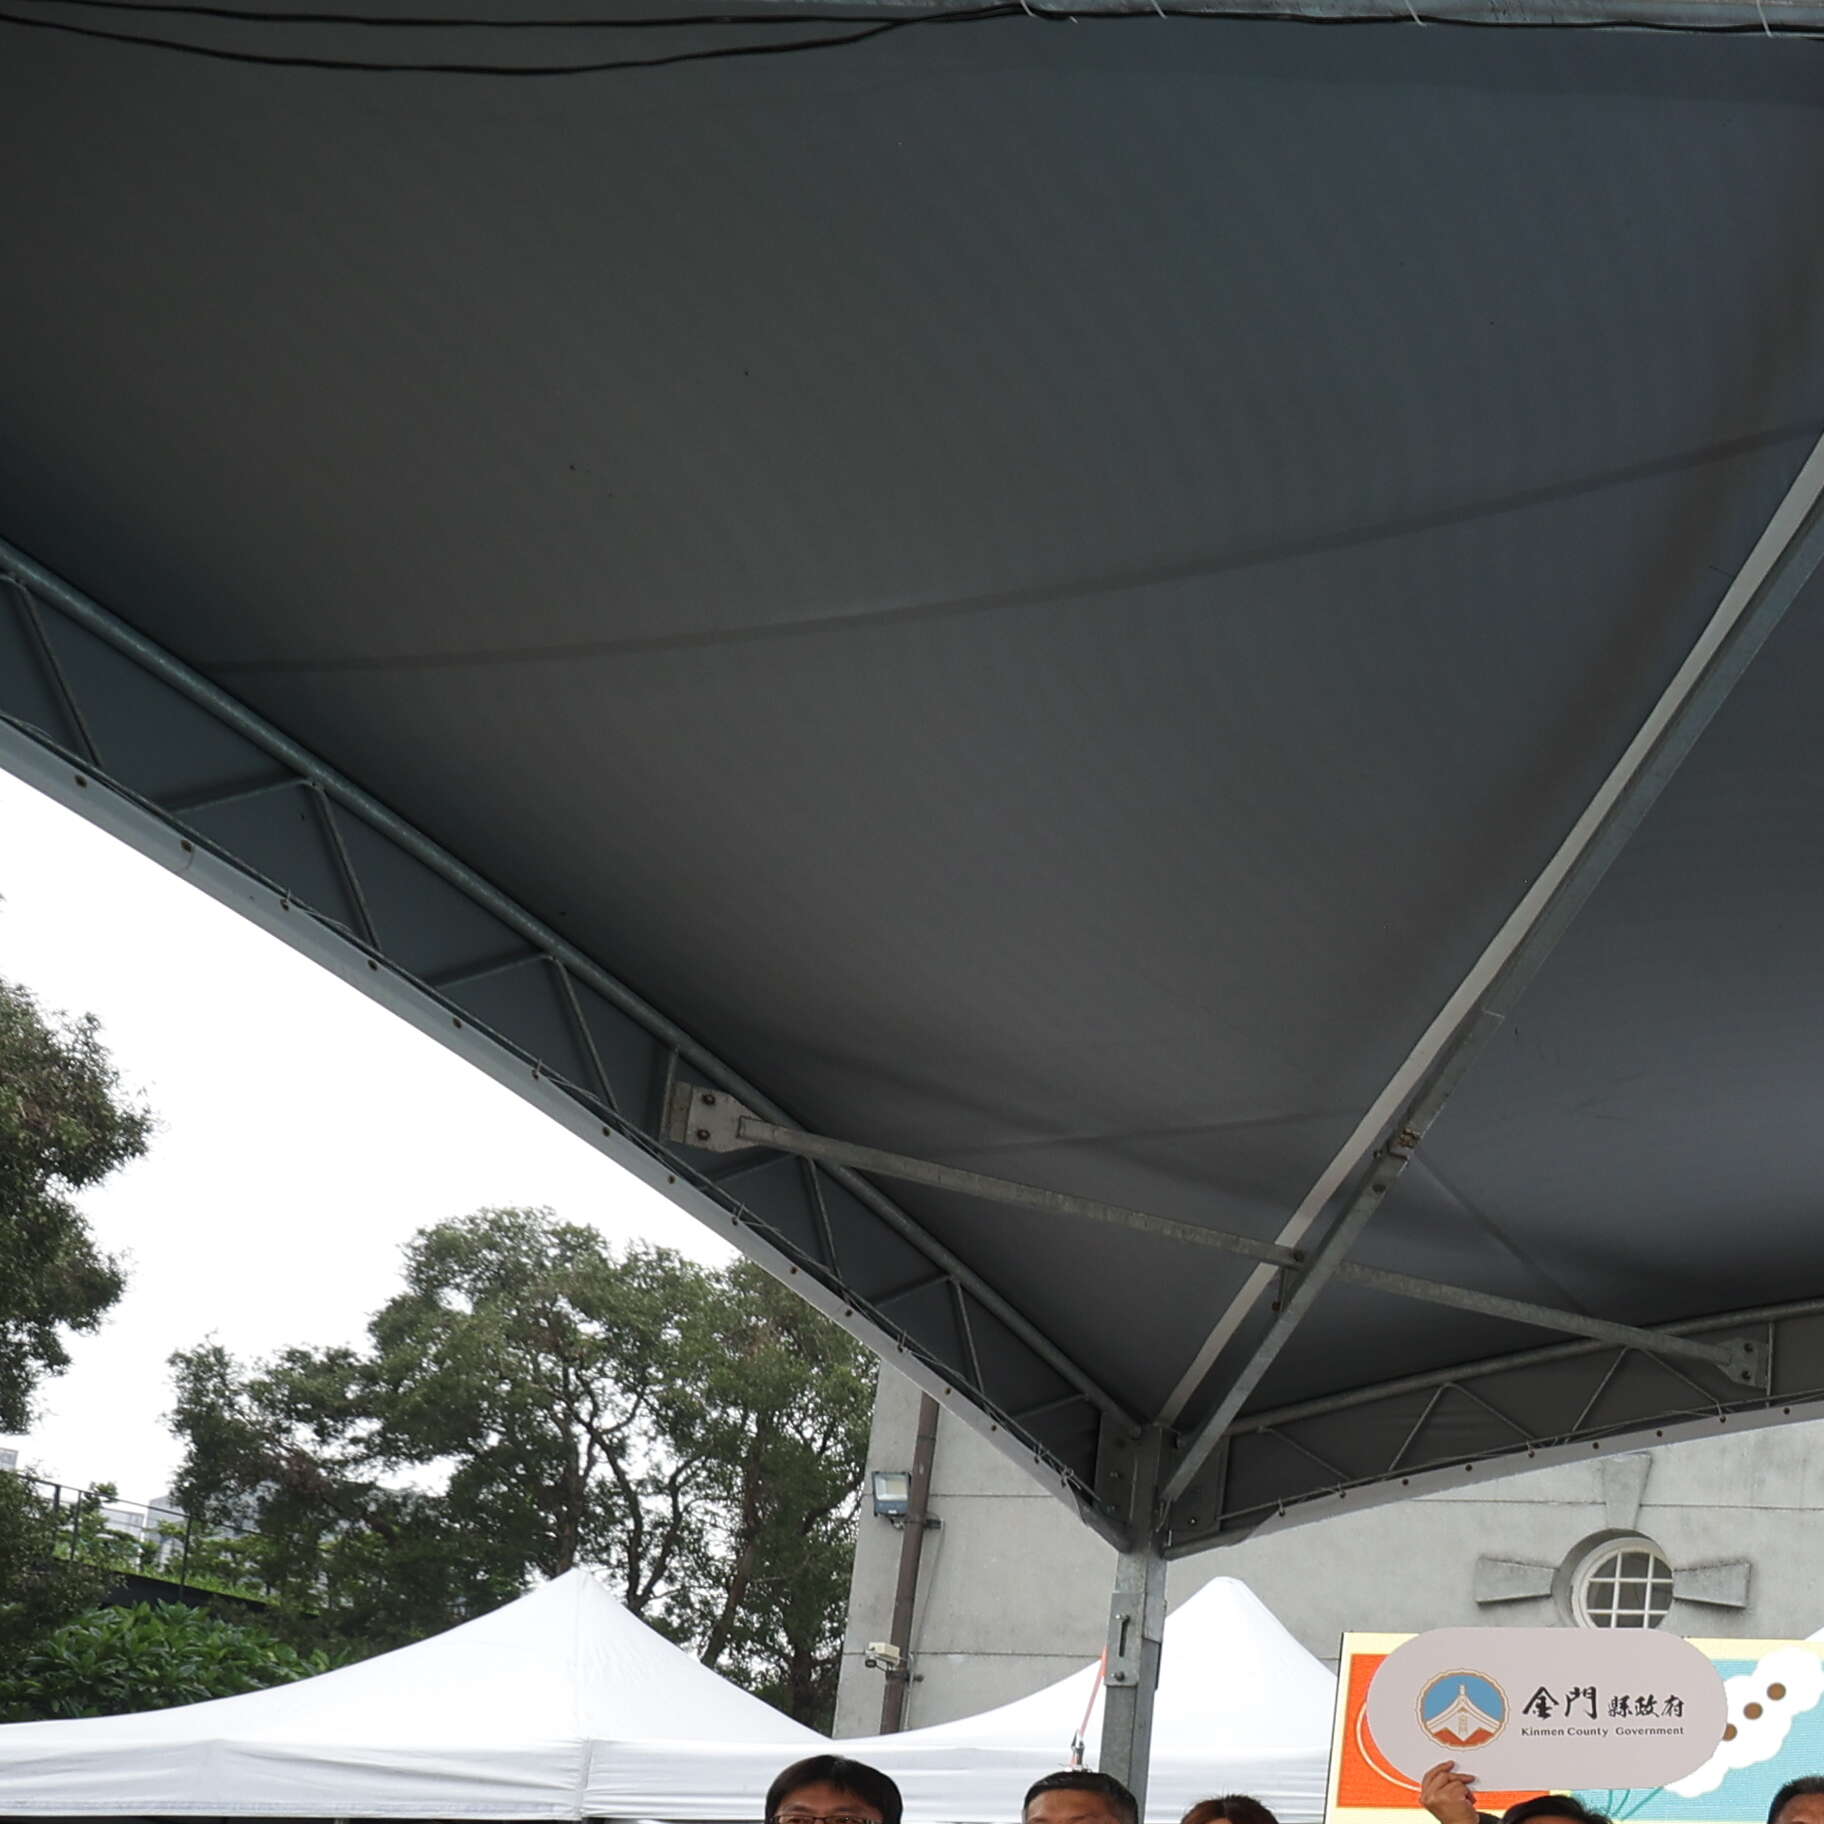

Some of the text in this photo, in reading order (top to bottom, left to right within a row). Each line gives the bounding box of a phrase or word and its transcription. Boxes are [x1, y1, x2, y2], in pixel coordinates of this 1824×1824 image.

[1521, 1686, 1685, 1720] 金門縣政府
[1521, 1726, 1685, 1738] Kinmen County Government
